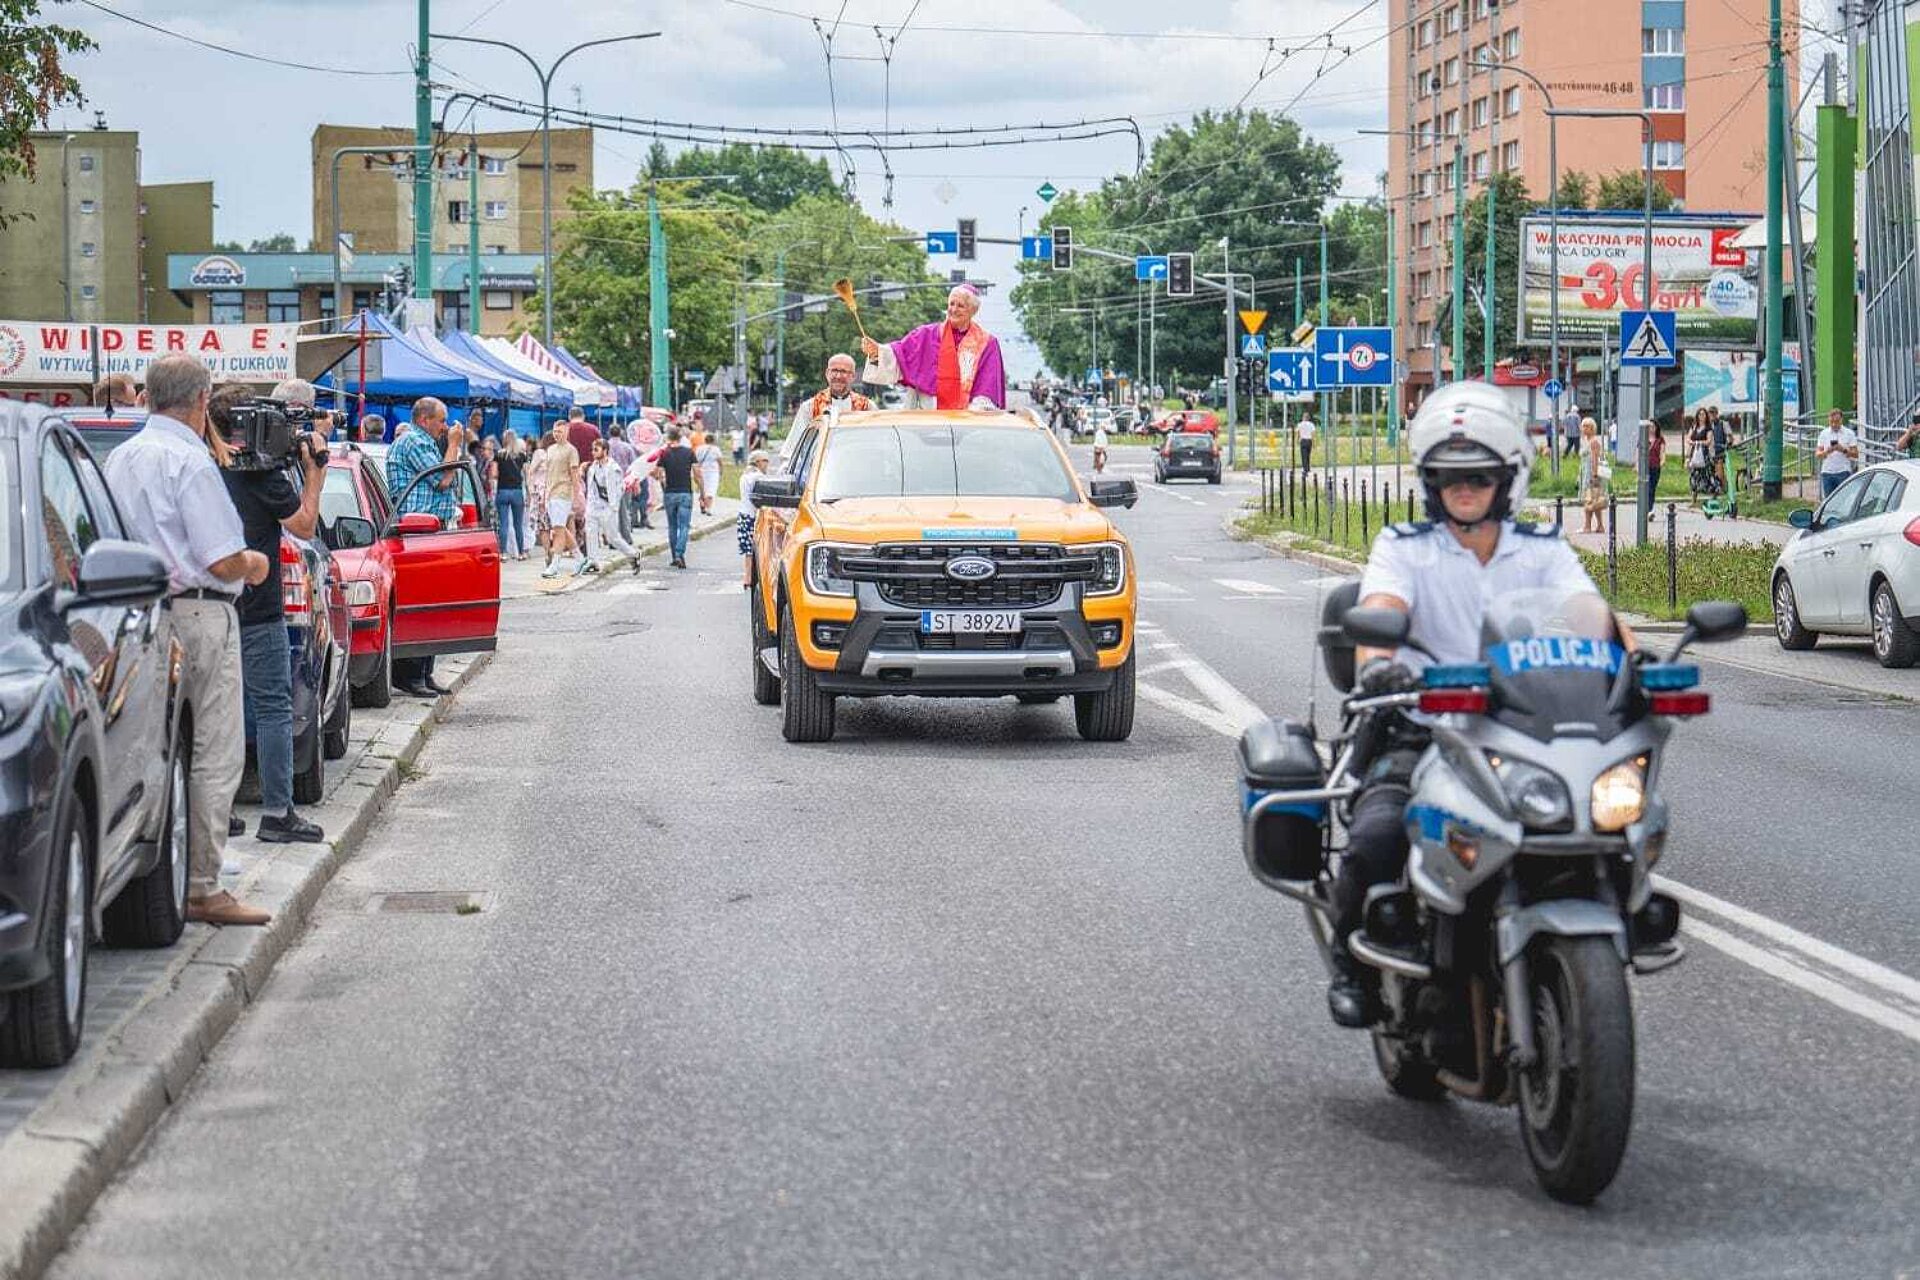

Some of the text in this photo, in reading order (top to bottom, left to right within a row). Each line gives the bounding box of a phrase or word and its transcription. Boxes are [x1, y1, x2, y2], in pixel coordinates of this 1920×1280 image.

[1535, 232, 1620, 245] WKACYJNA
[1582, 246, 1601, 257] DO
[1604, 247, 1628, 258] GRY
[40, 327, 221, 351] WIDERA
[40, 357, 130, 372] WYTWNIA
[960, 562, 984, 574] Ford
[934, 613, 1016, 631] ST 3892V
[1507, 637, 1617, 674] POLICJA
